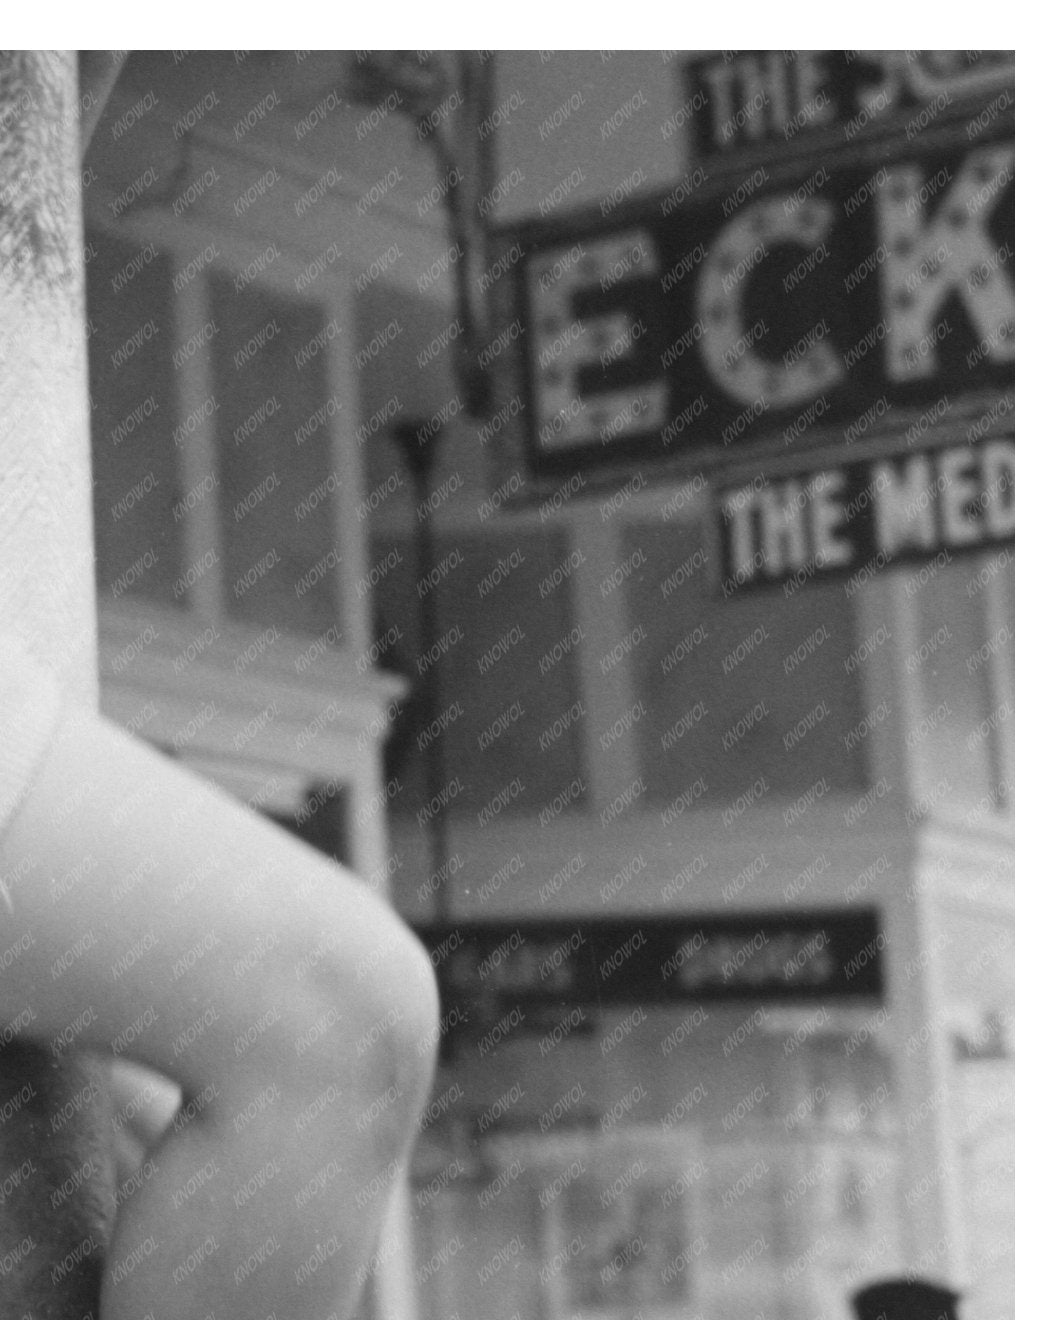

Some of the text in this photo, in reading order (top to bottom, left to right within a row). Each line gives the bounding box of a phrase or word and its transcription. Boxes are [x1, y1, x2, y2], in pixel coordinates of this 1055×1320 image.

[706, 50, 834, 147] THE
[527, 146, 1014, 453] ECK
[724, 470, 852, 580] THE
